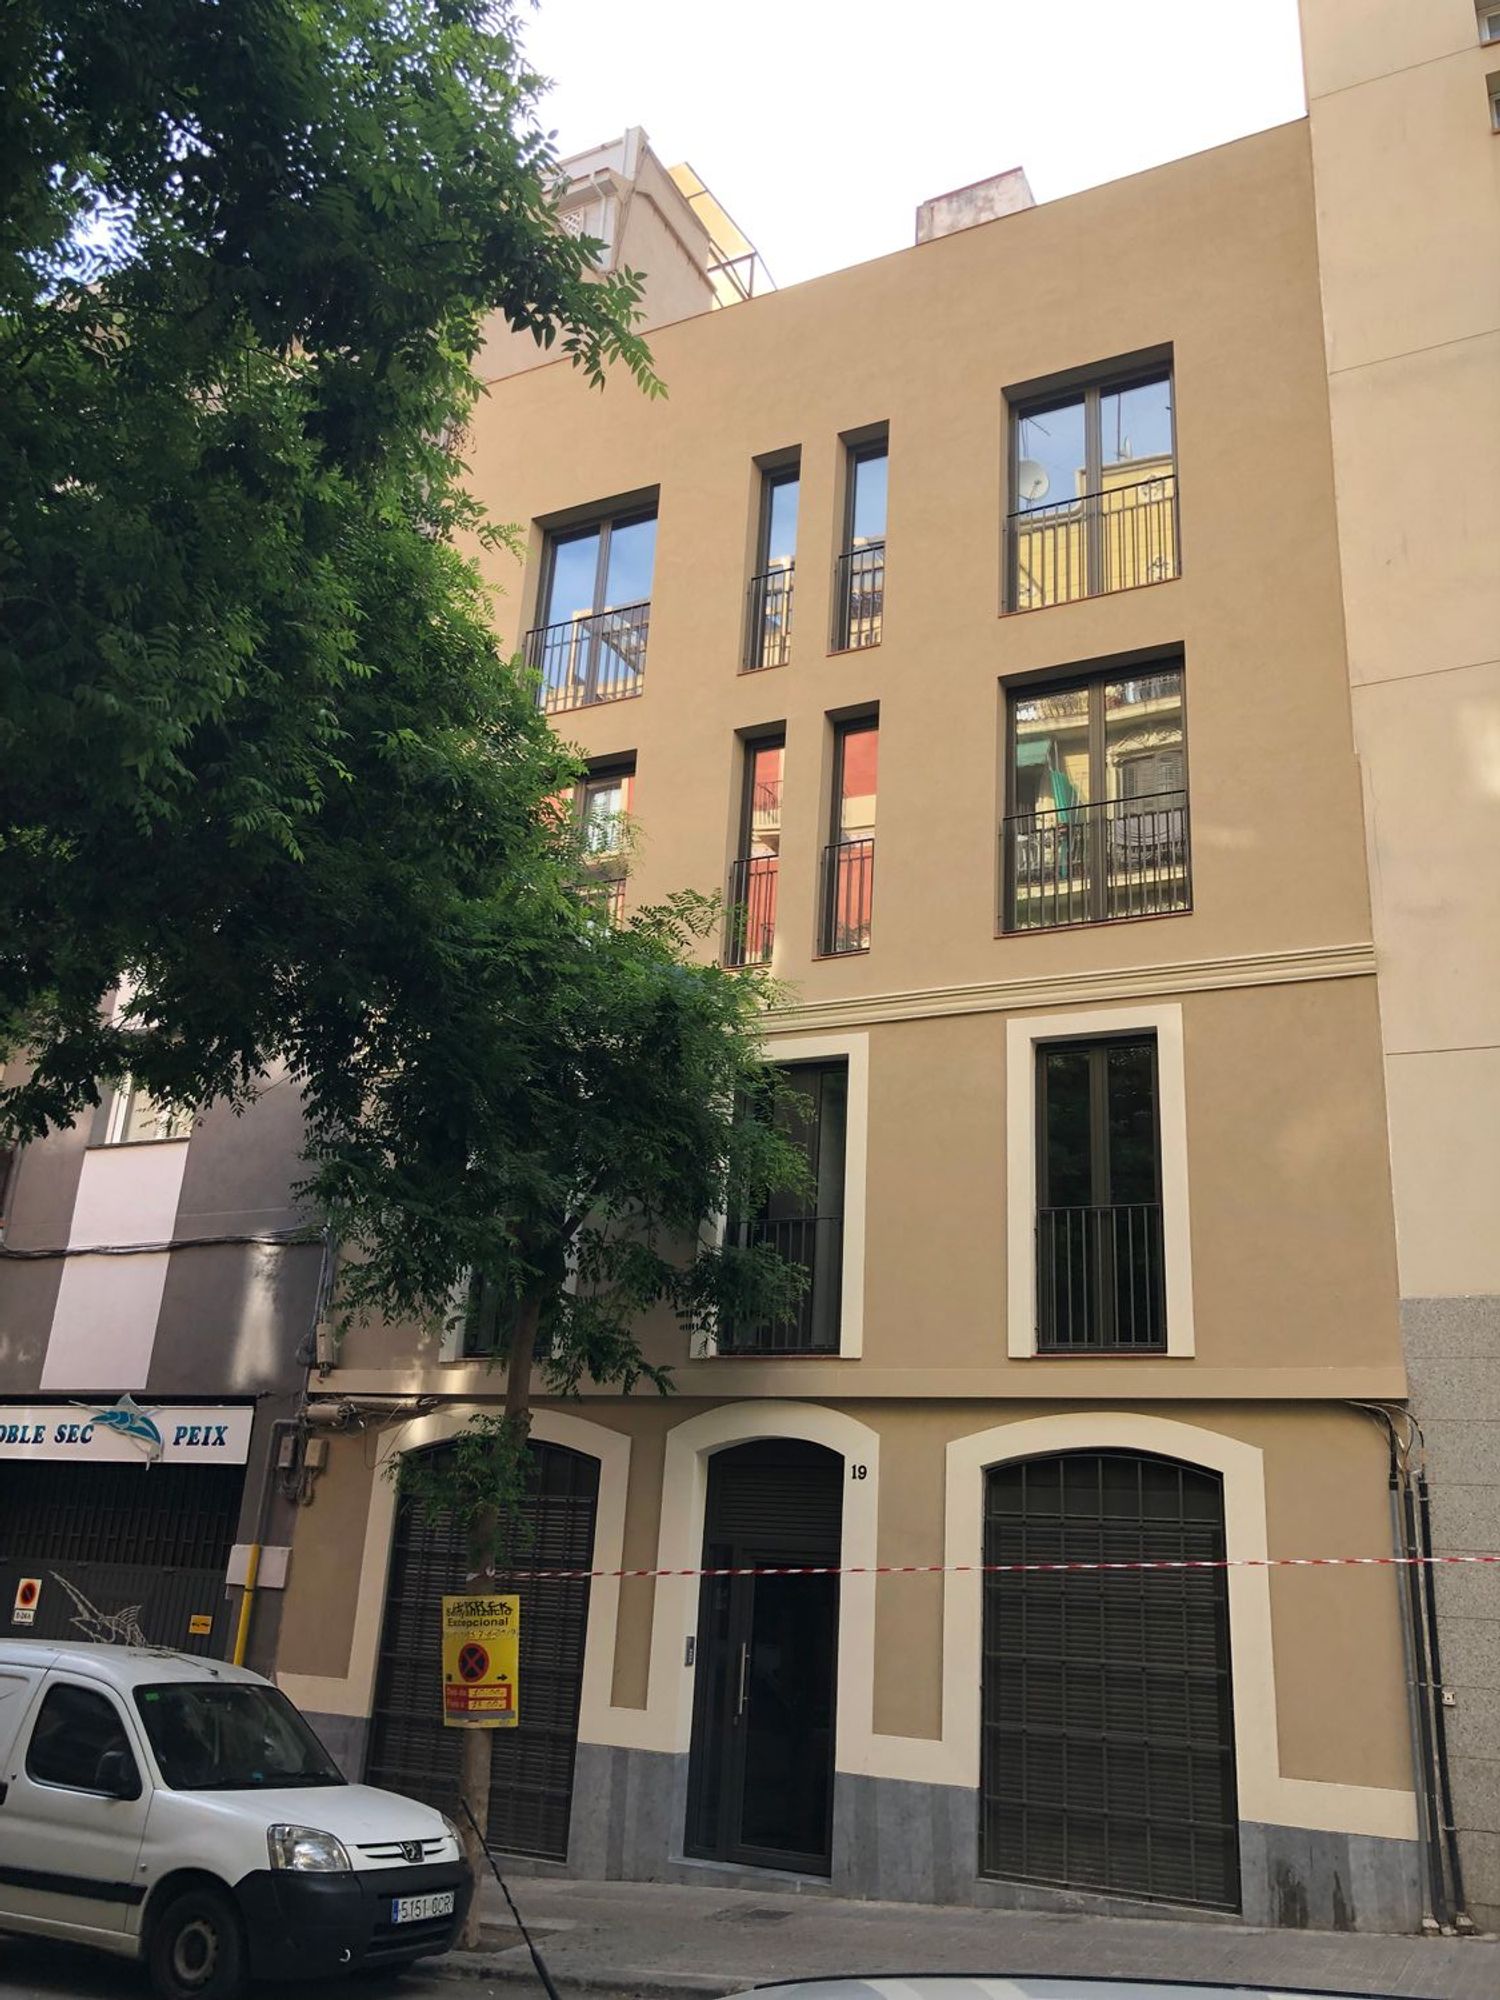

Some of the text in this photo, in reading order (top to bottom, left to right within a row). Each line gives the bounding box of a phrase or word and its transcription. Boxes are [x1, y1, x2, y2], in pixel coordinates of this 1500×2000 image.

[54, 1424, 94, 1444] SEC
[173, 1425, 229, 1446] PEIX
[851, 1464, 867, 1480] 19
[401, 1898, 427, 1919] 5151
